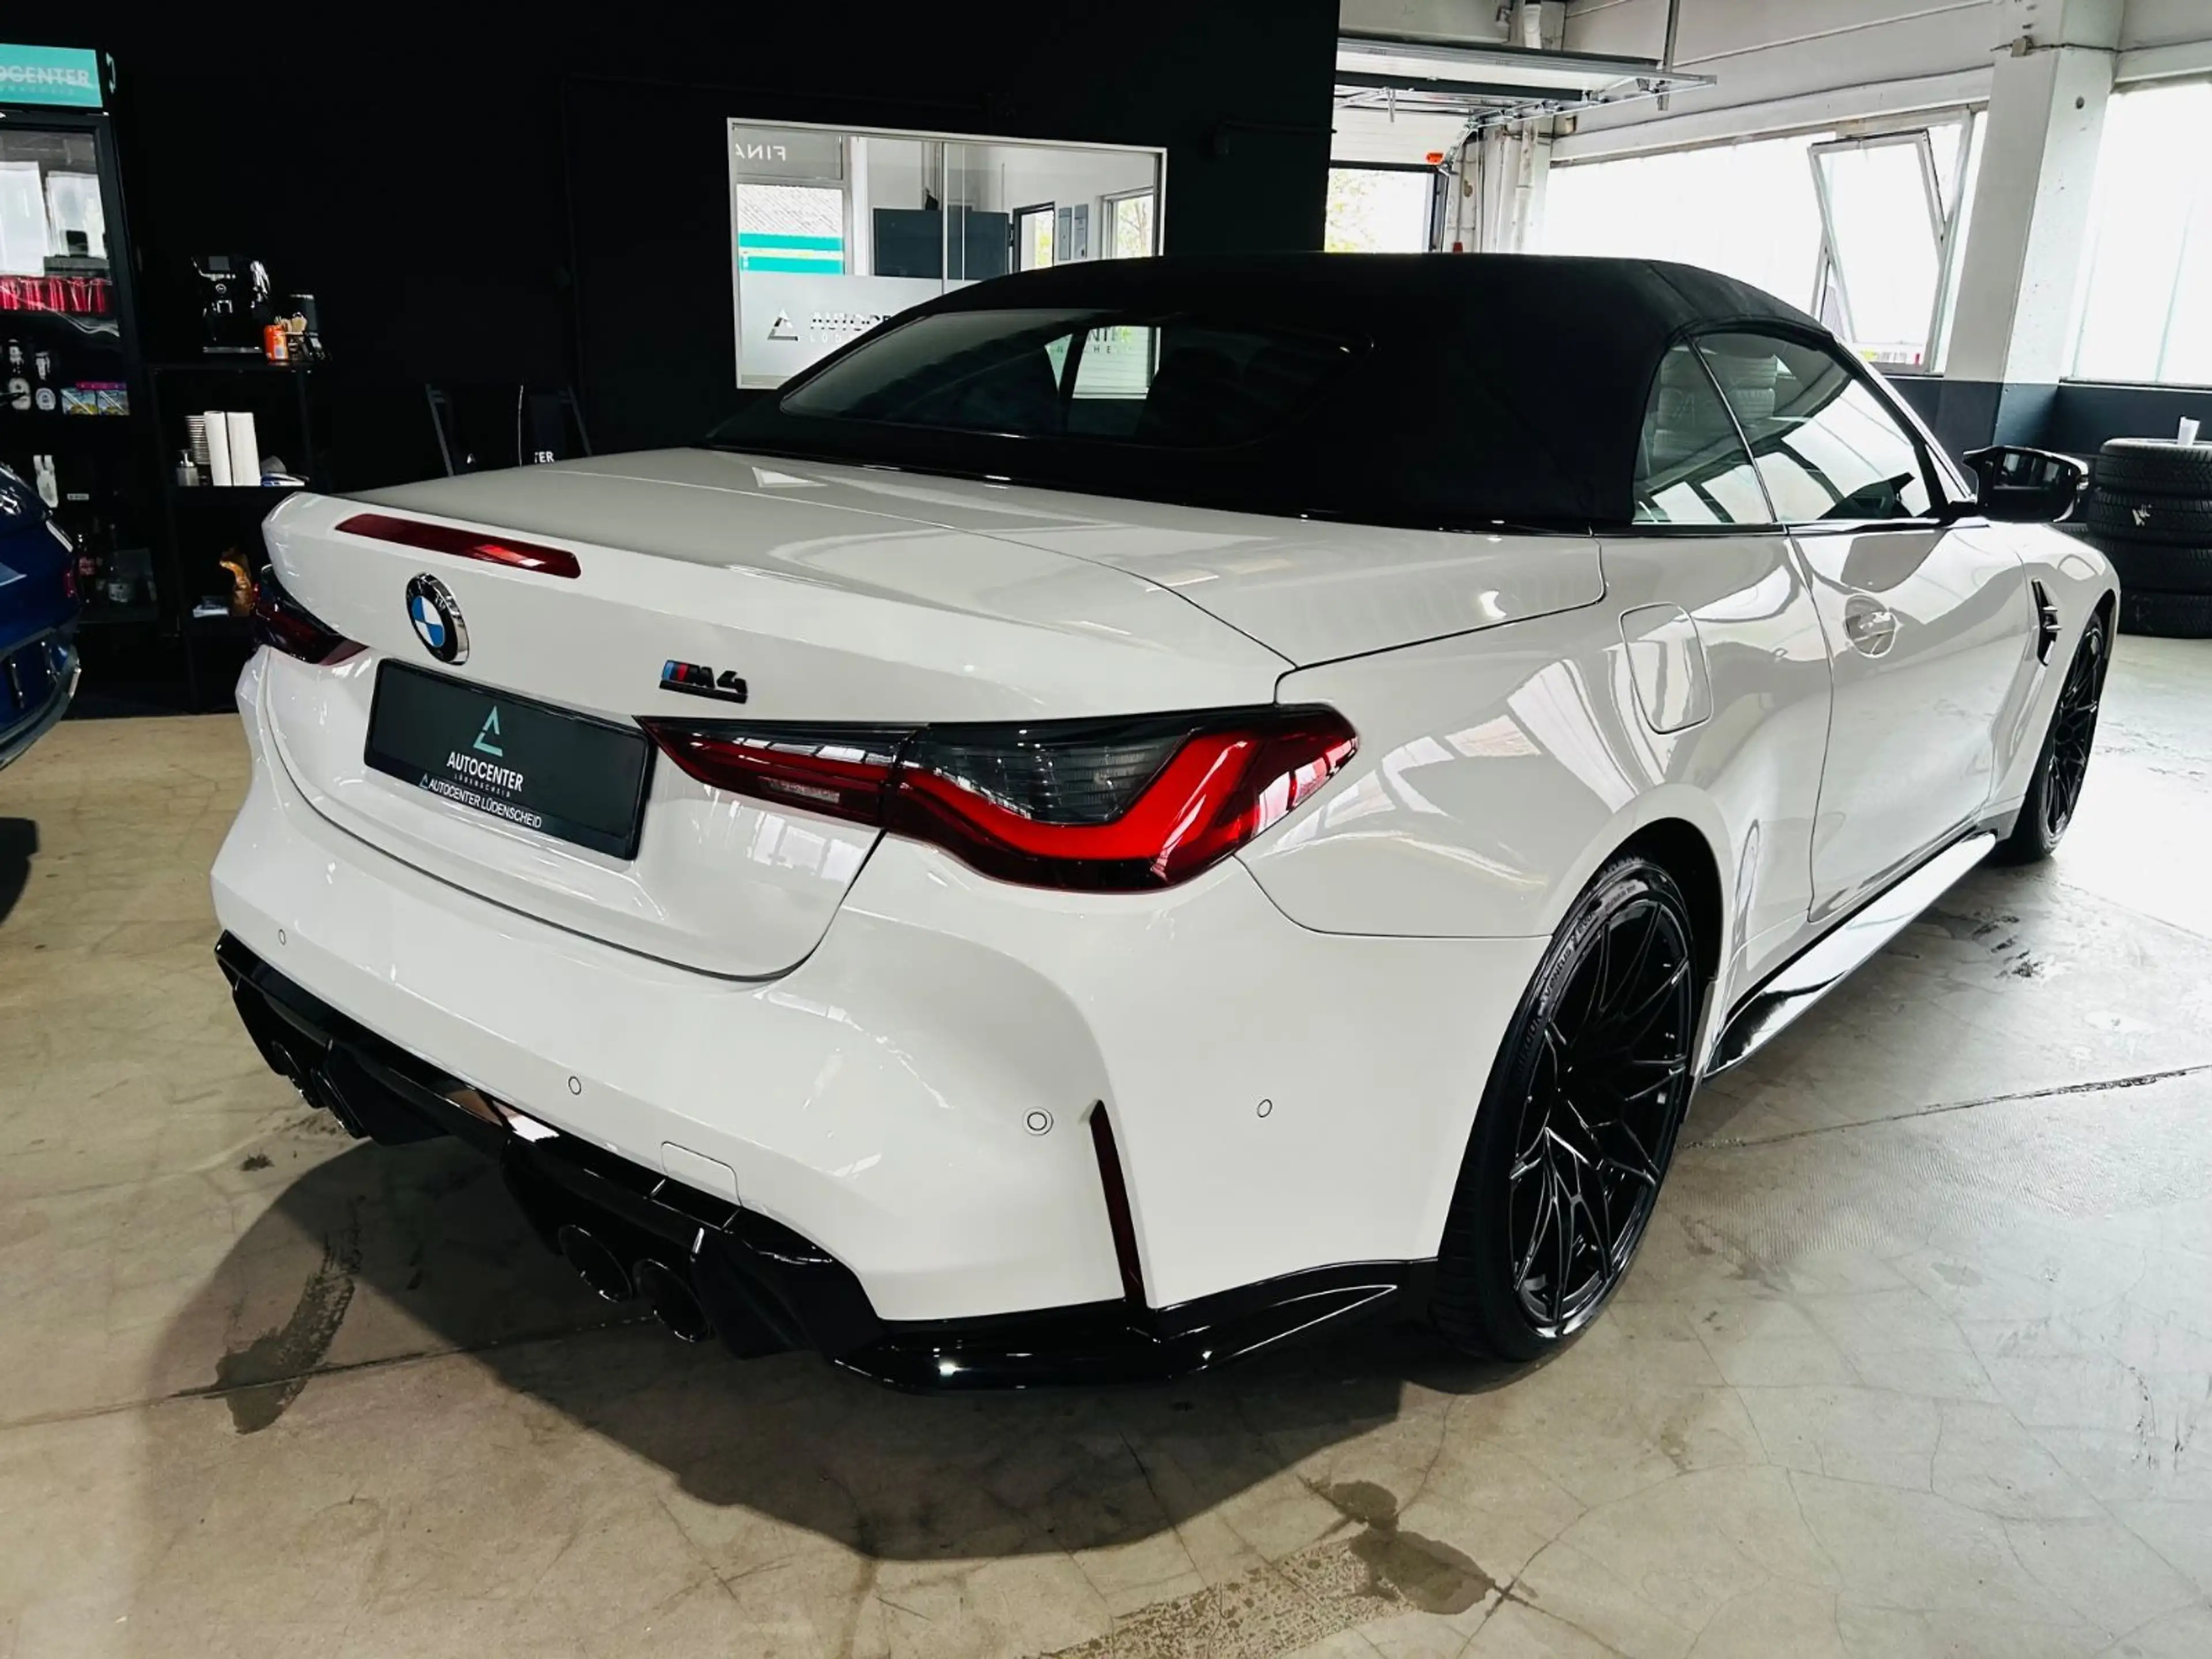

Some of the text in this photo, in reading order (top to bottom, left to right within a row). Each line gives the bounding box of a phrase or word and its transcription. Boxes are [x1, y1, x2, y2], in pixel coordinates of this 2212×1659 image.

[661, 660, 748, 695] M4
[446, 751, 524, 793] AUTOCENTER
[429, 778, 542, 828] AUTOCENTER LÜDENSCHEID
